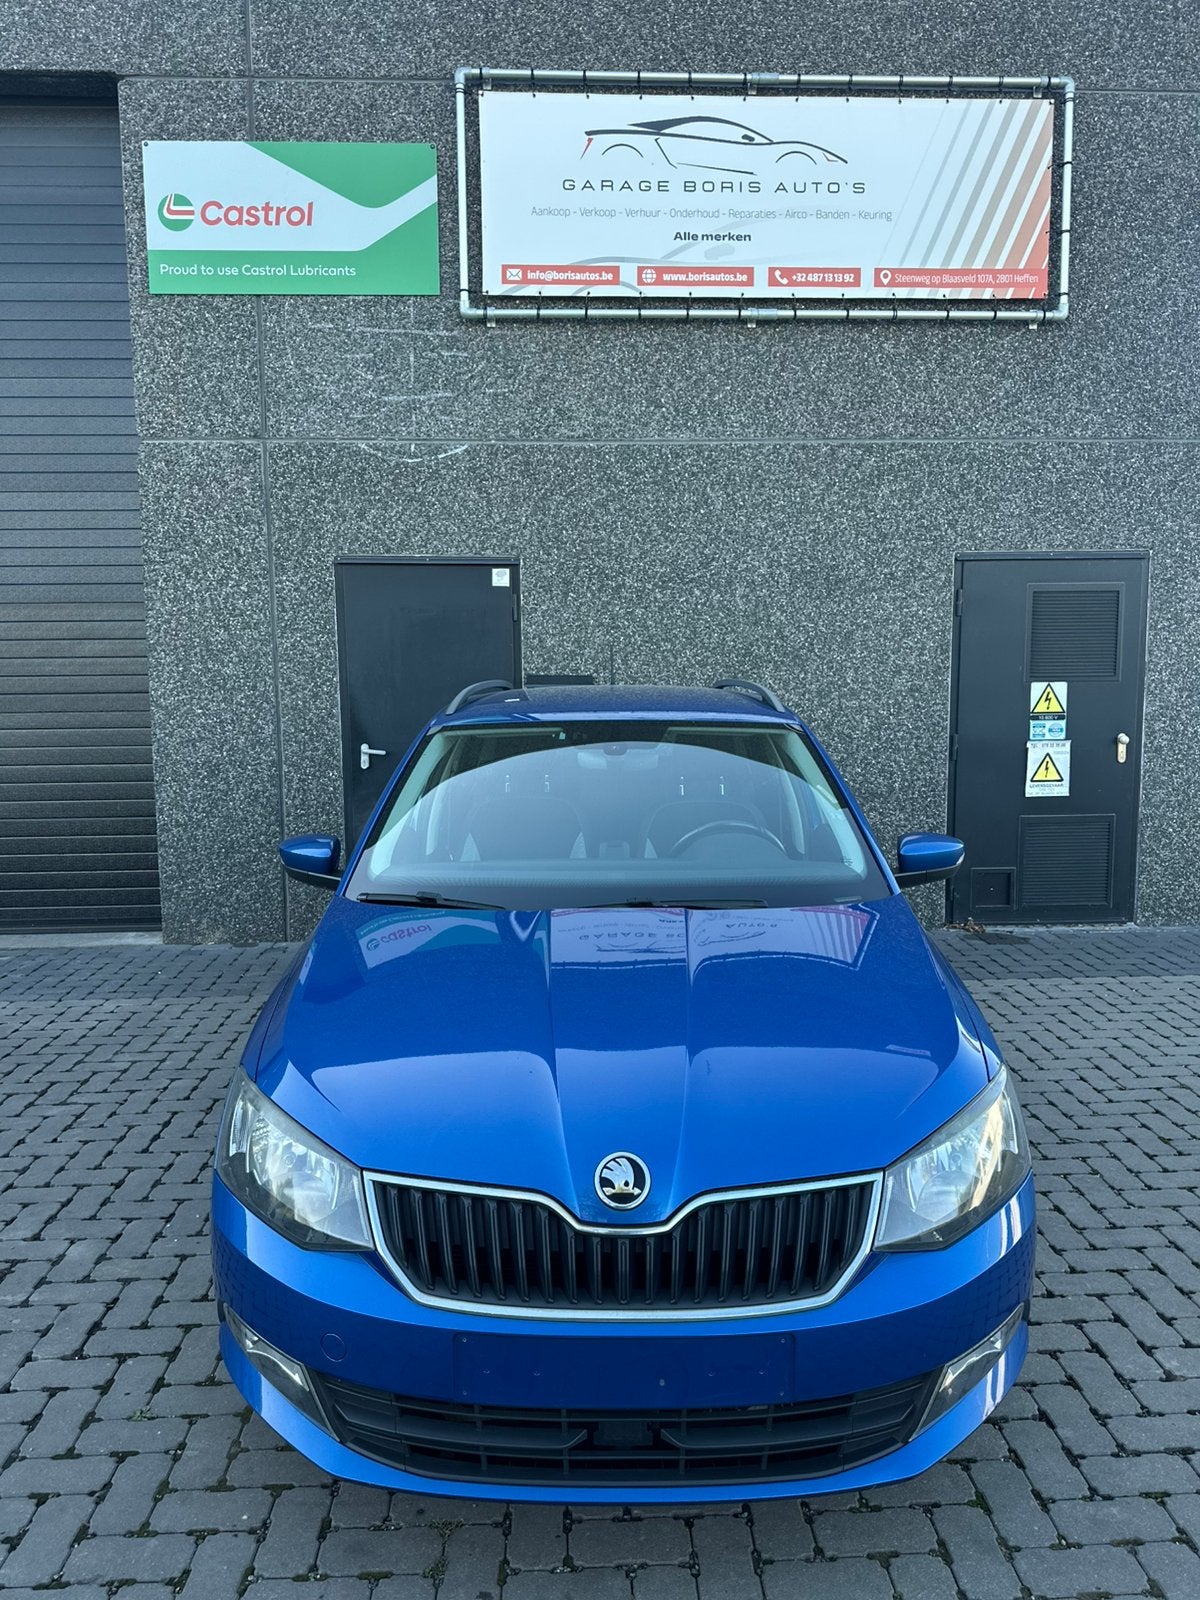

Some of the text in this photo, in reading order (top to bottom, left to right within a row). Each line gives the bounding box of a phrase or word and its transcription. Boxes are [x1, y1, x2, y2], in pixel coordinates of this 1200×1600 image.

[562, 178, 865, 194] GARAGE BORIS AUTO'S
[200, 200, 314, 226] Castrol
[531, 206, 571, 218] Aankoop
[579, 206, 617, 219] Verkoop
[625, 207, 660, 218] Verhuur
[669, 208, 720, 219] Onderhoud
[728, 208, 777, 220] Reparaties
[785, 209, 808, 219] Airco
[816, 209, 850, 219] Banden
[858, 210, 893, 222] Keuring
[673, 231, 752, 242] Alle merken
[160, 263, 356, 277] Proud to use Castrol Lubricants
[527, 270, 613, 281] info@borisautos.be
[663, 272, 748, 283] www.borisautos.be
[895, 273, 1039, 285] Steenweg op Blaasveld 107A, 2801 Heffen
